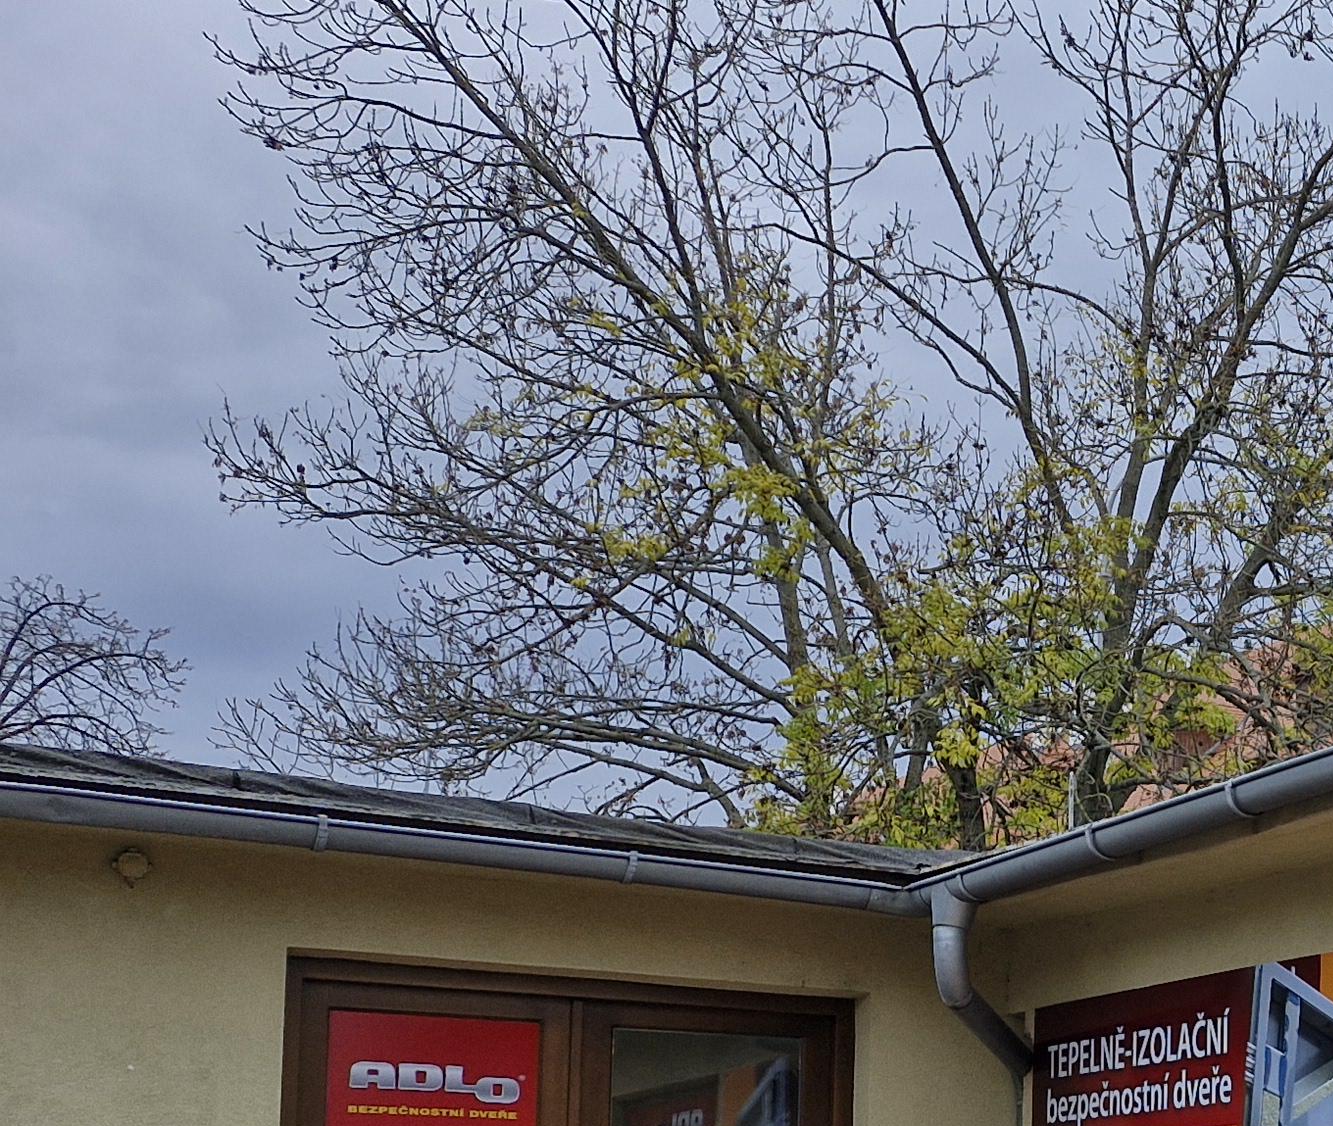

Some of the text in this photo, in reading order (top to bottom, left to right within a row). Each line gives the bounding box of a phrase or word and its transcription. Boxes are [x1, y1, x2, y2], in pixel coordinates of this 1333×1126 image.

[1047, 1007, 1231, 1079] TEPELNĚ-IZOLAČNÍ
[1173, 1065, 1232, 1109] dveře
[347, 1105, 518, 1120] BEZPEČNOSTNÍ DVEŘE
